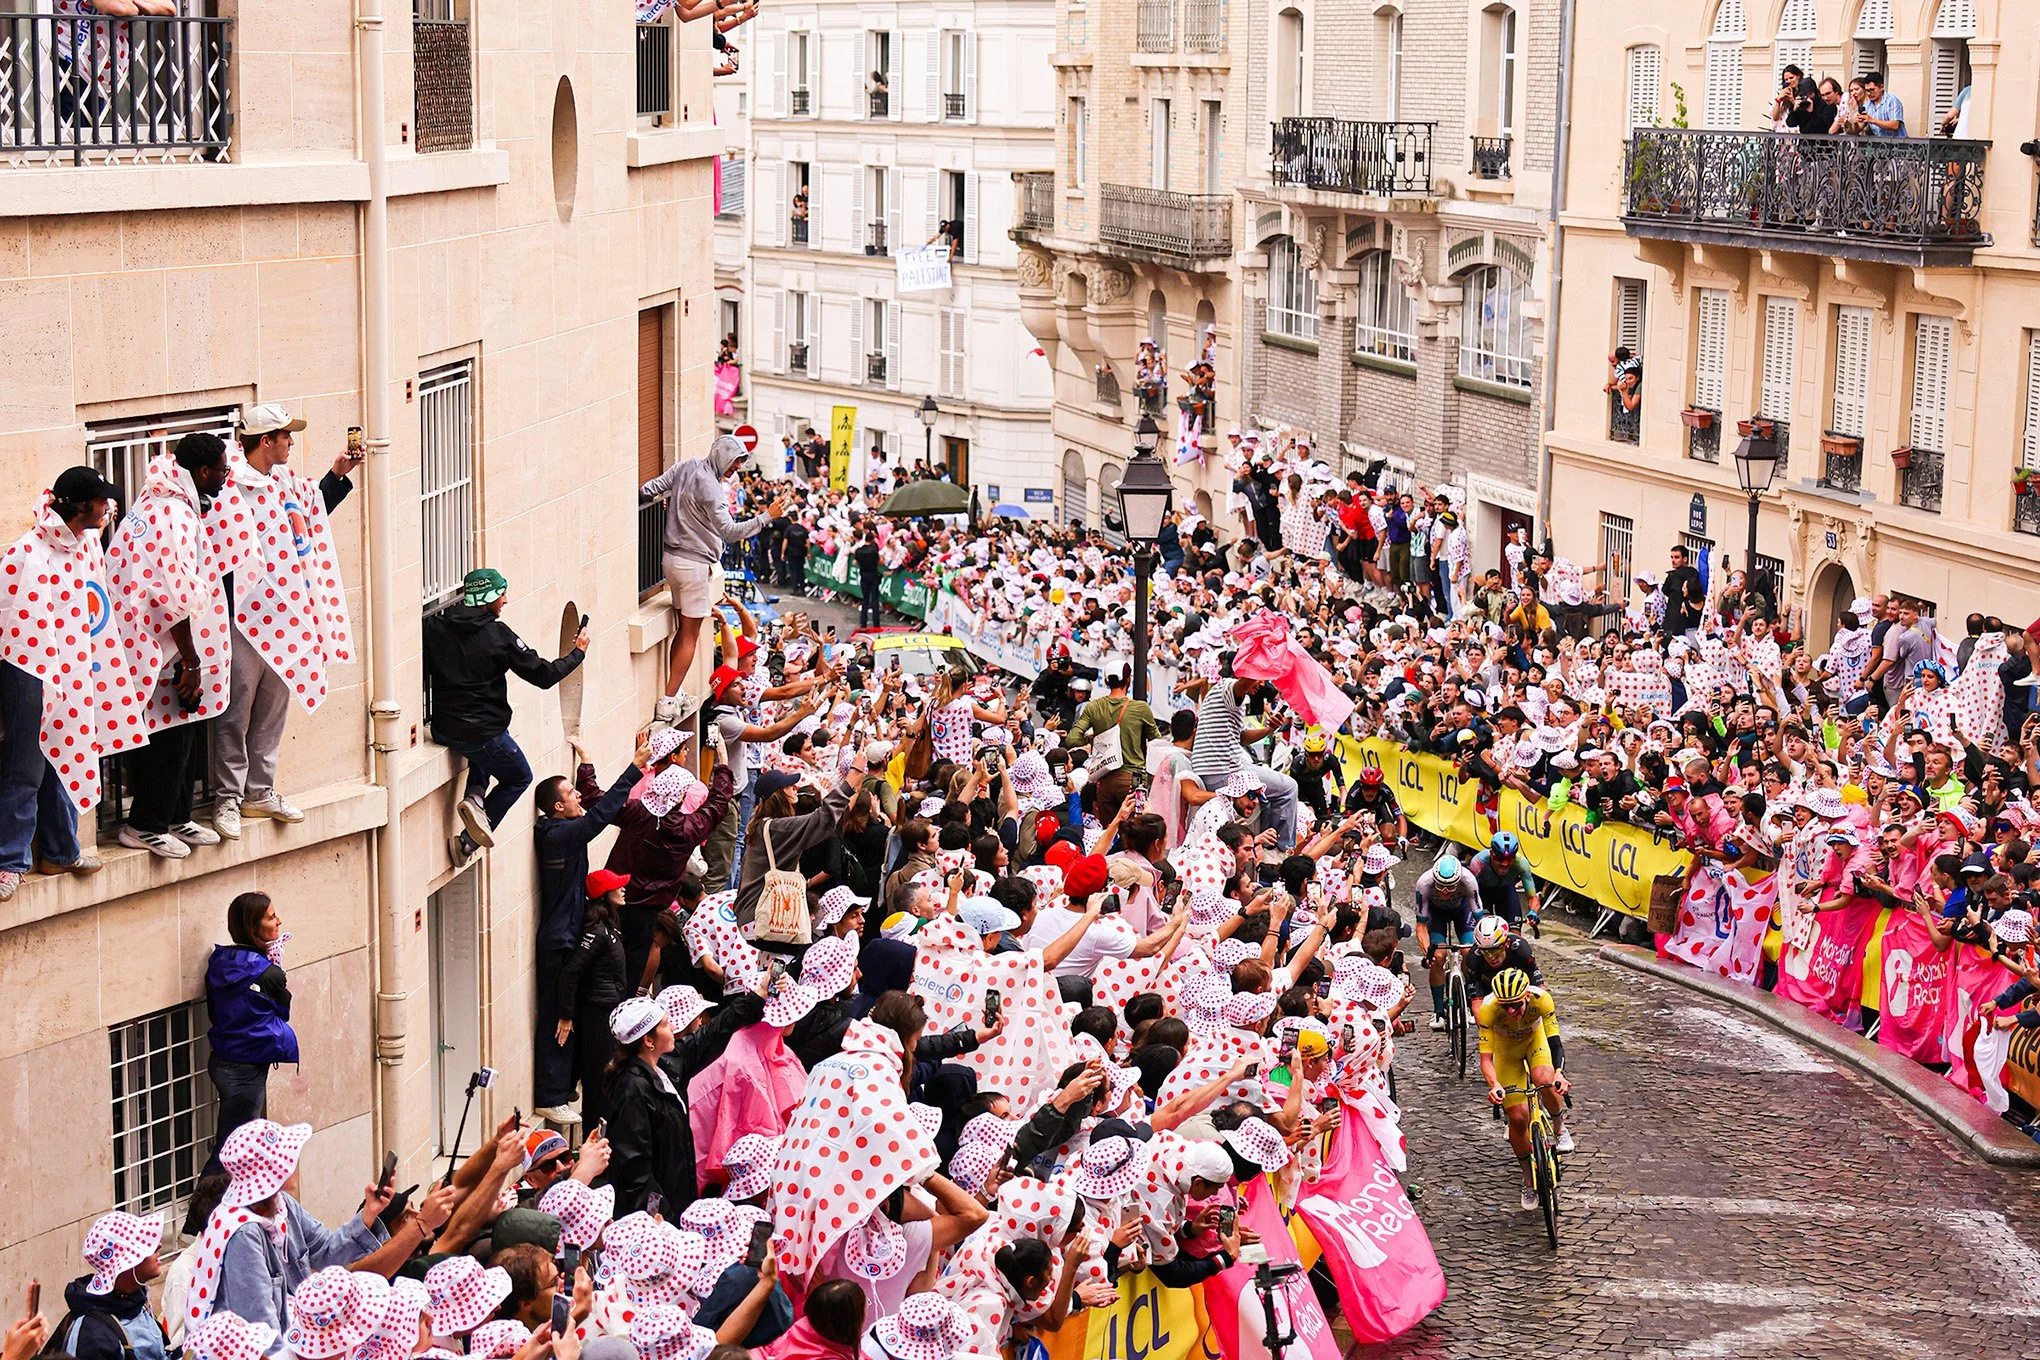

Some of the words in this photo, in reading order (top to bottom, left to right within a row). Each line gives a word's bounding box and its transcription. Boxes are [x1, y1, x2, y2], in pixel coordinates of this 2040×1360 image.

[902, 265, 949, 288] PALESTINE
[1827, 532, 1836, 548] 53
[1400, 759, 1424, 792] LCL
[1438, 771, 1459, 806] LCL
[1518, 801, 1545, 840] LCL
[1561, 819, 1591, 860] LCL
[1610, 838, 1640, 881] LCL
[626, 1013, 655, 1038] PEUGEOT
[1335, 1160, 1399, 1227] Mondi
[1360, 1193, 1417, 1243] Rela
[1109, 1286, 1170, 1360] LCL
